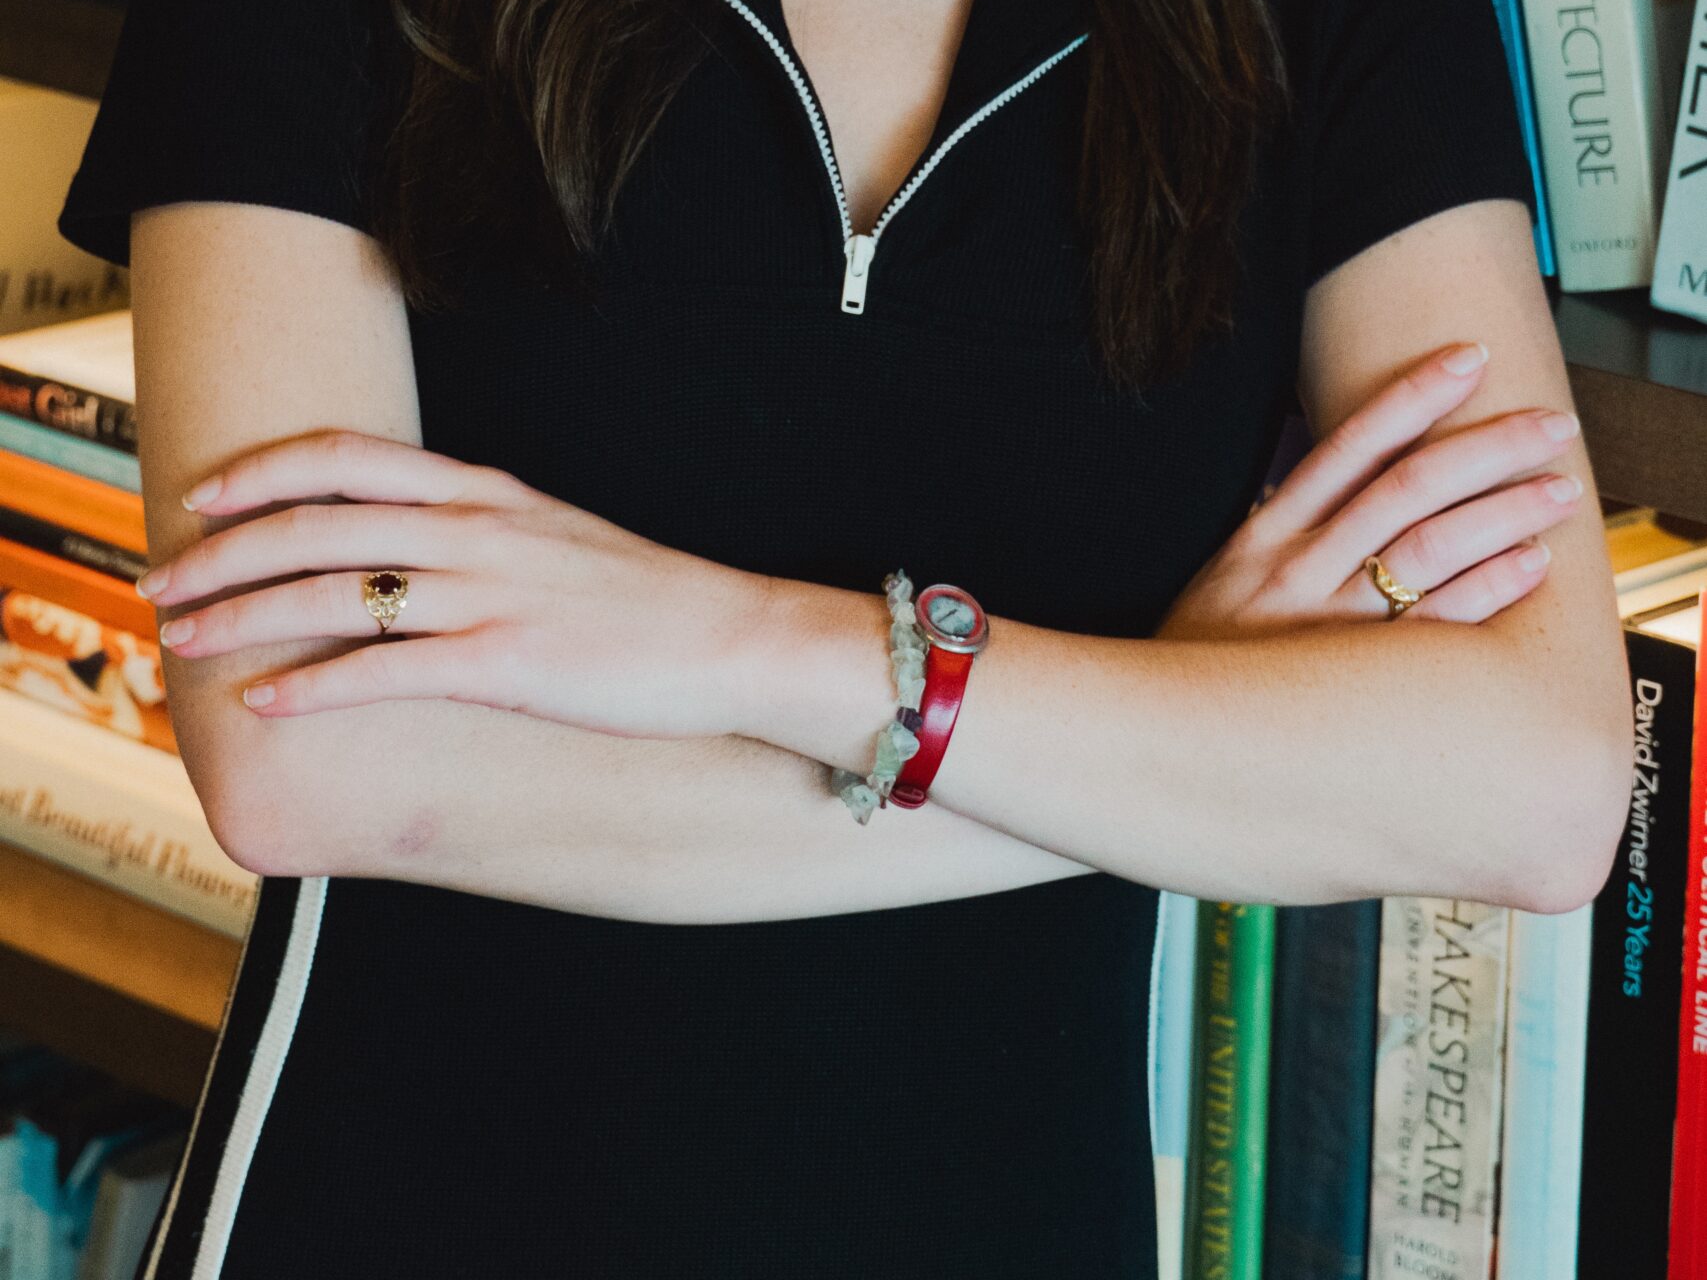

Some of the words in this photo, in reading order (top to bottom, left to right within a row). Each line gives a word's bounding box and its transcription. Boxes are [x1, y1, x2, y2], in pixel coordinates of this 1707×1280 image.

[1569, 237, 1638, 253] OXFORD
[1634, 677, 1663, 770] David
[1627, 768, 1660, 883] Zwirner
[1626, 882, 1655, 921] 25
[1403, 906, 1423, 1047] INVENTION
[1622, 926, 1651, 998] Years
[1422, 899, 1474, 1224] HAKESPEARE
[1393, 1232, 1458, 1265] HAROLD
